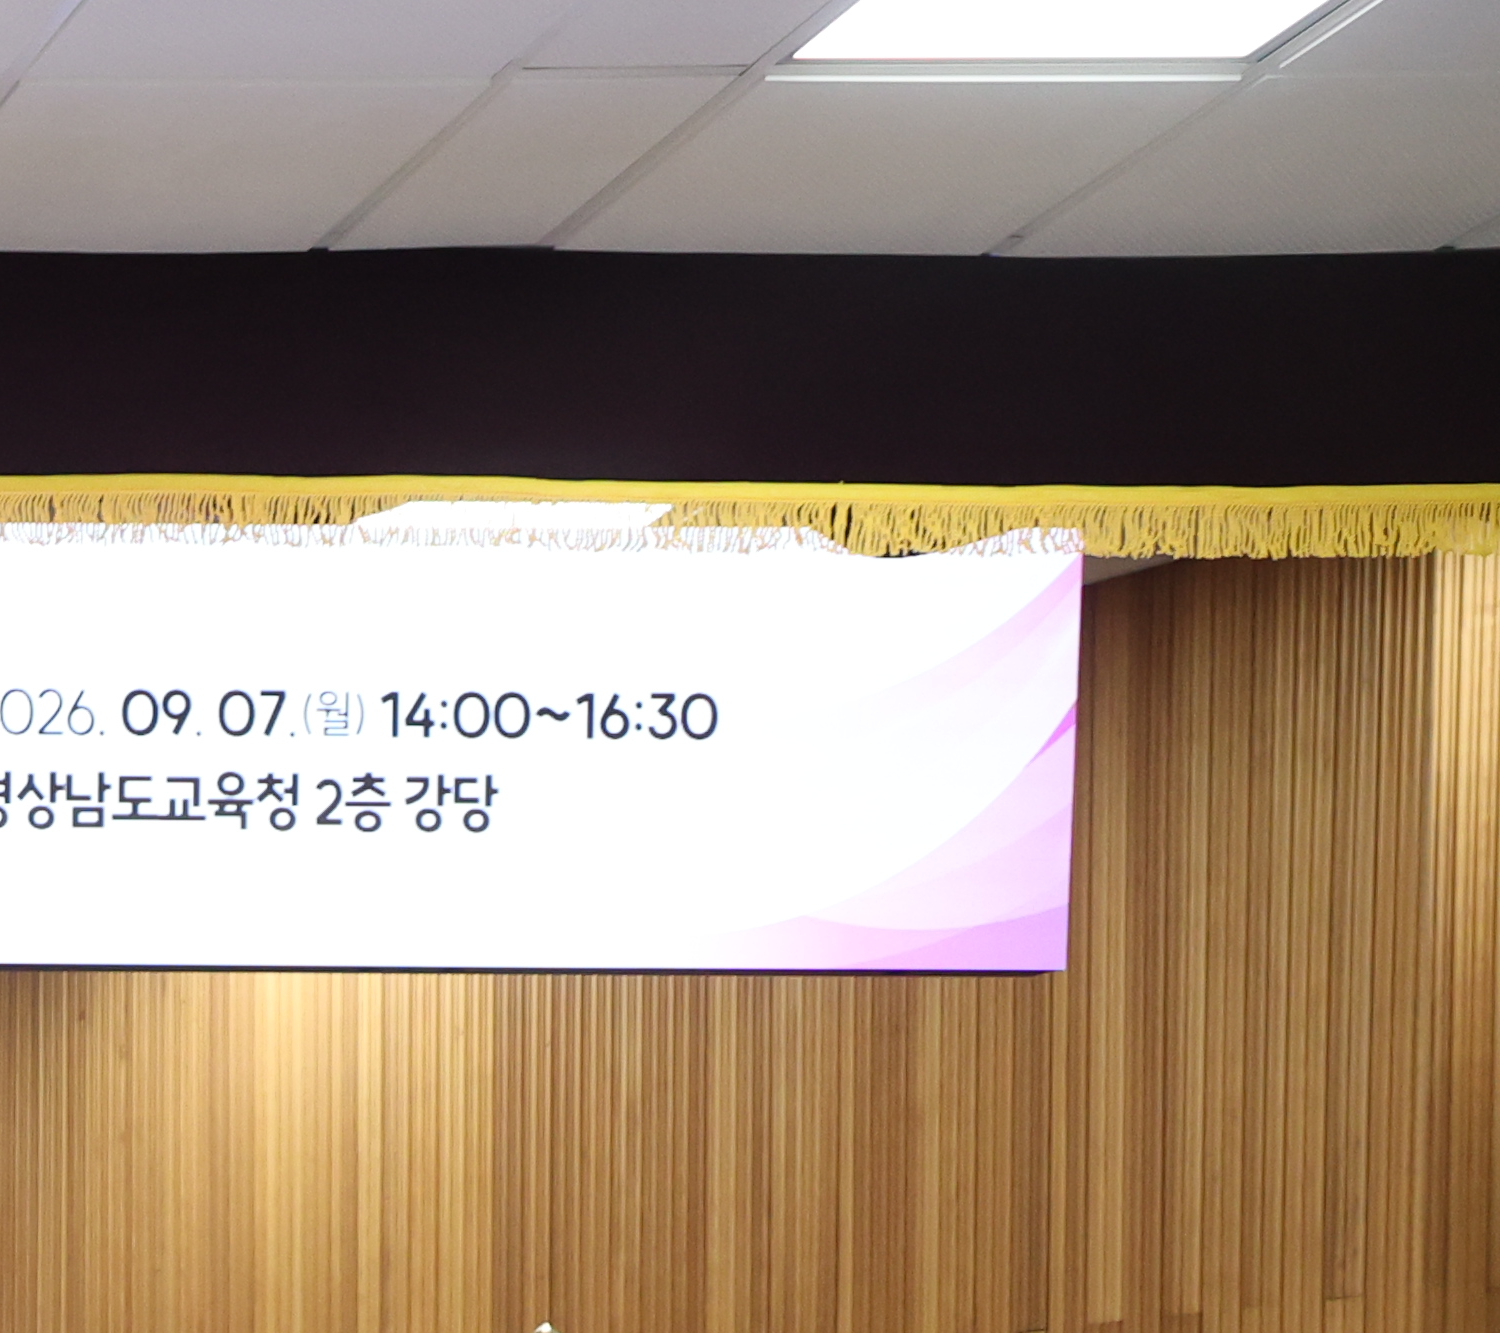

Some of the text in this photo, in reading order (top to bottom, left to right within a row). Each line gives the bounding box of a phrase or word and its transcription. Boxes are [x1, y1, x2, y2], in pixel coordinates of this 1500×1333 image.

[122, 688, 201, 736] 09.
[381, 691, 719, 740] 14:00~16:30
[316, 772, 392, 833] 2층
[405, 774, 500, 833] 강당
